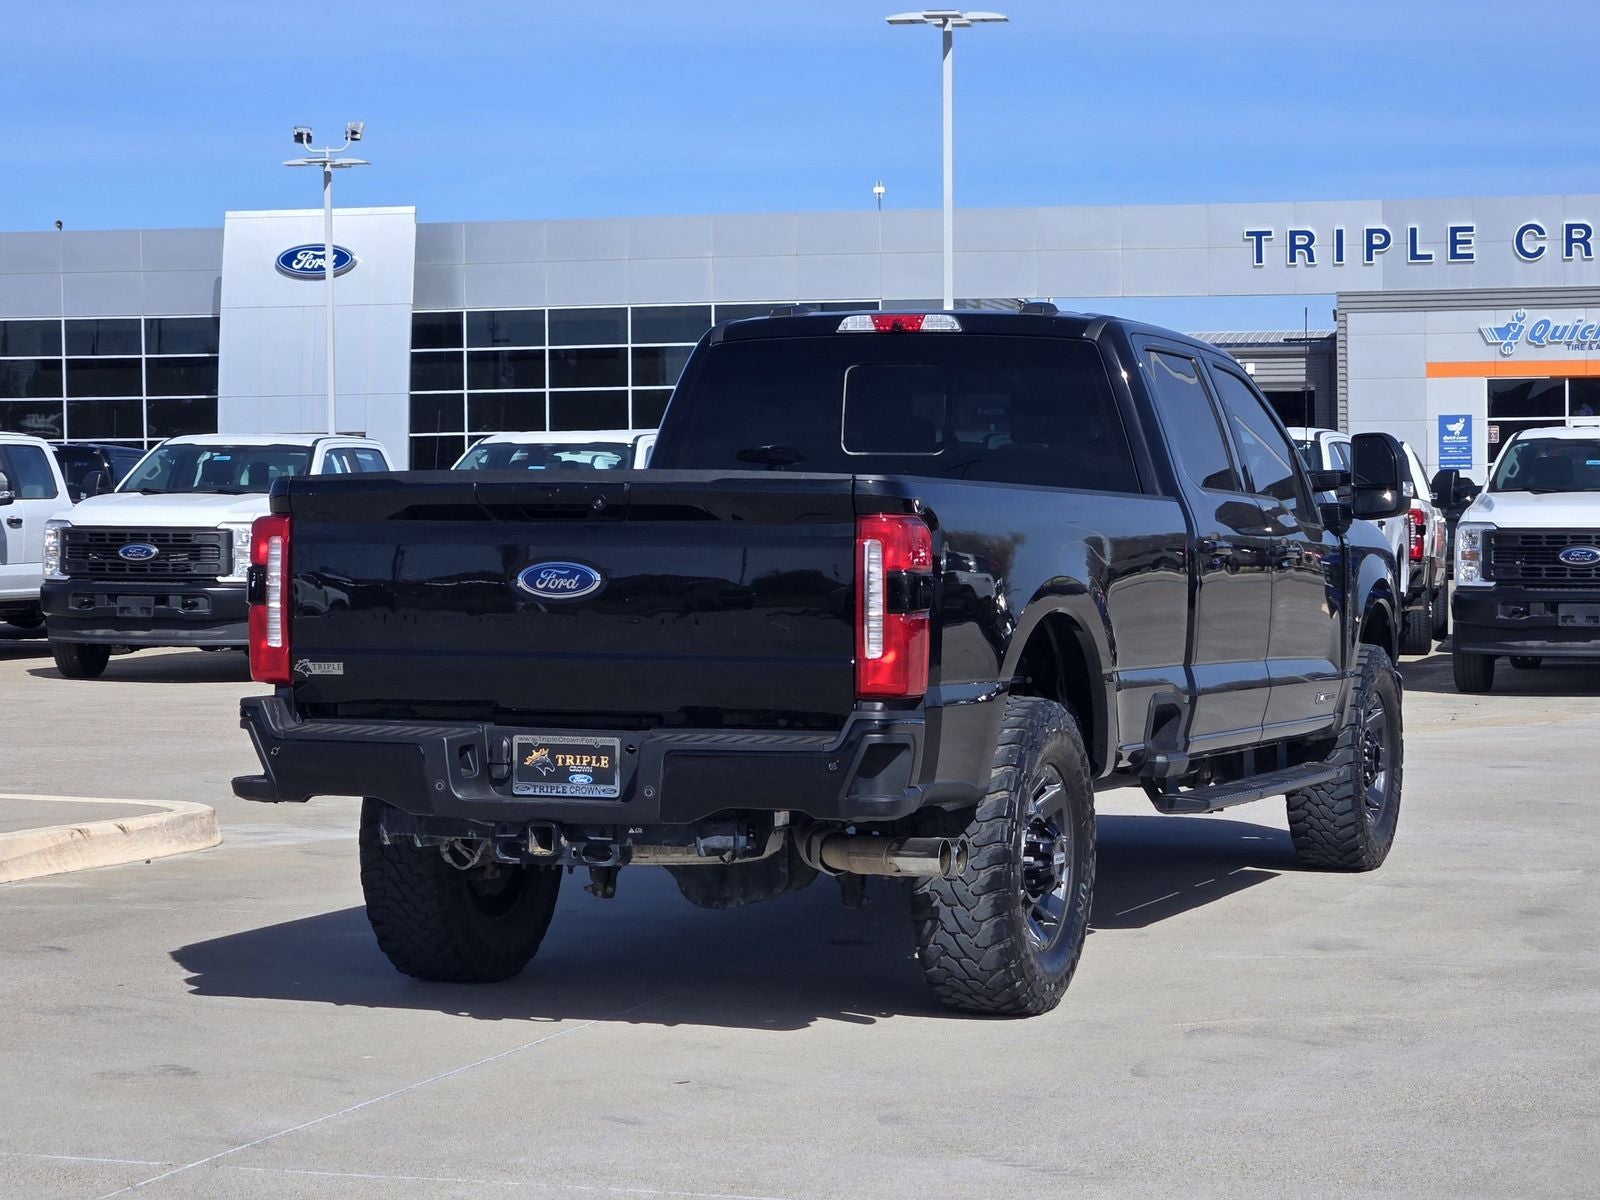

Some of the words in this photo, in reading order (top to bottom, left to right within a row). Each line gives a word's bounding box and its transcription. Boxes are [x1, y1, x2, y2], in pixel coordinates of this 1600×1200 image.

[1245, 225, 1475, 265] TRIPLE
[1566, 343, 1586, 351] TIRE
[536, 568, 580, 589] Ford
[312, 663, 342, 671] TRIPLE
[555, 754, 609, 768] TRIPLE
[532, 785, 567, 794] TRIPLE
[569, 786, 601, 795] CROWN
